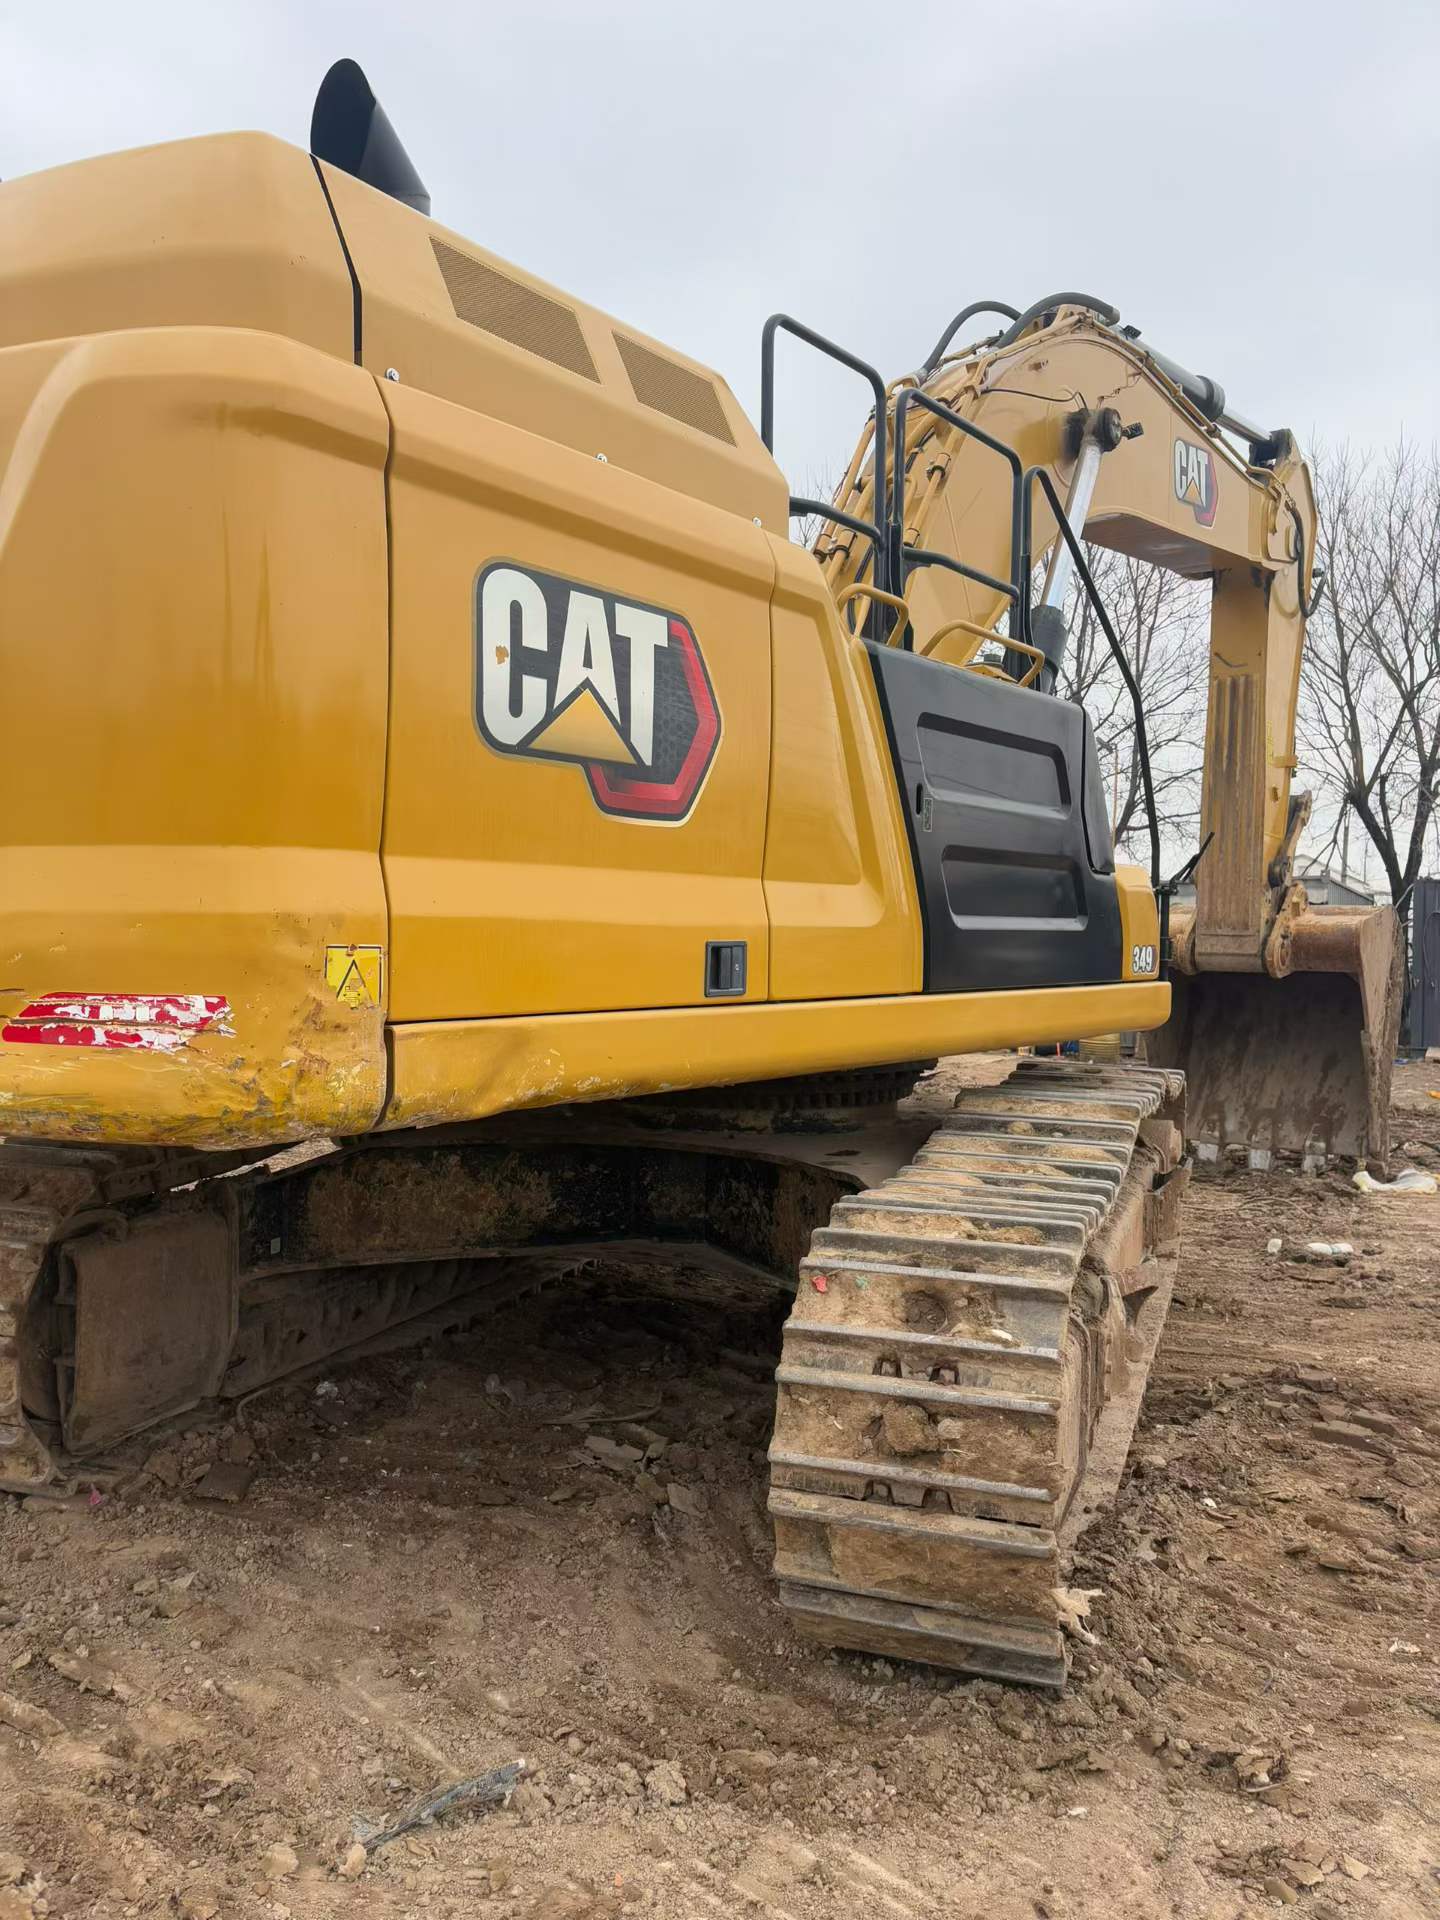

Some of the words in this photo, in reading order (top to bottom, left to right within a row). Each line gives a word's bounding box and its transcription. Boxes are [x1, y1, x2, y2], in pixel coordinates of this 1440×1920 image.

[1174, 439, 1209, 508] CAT
[481, 567, 669, 767] CAT
[1132, 945, 1153, 973] 349
